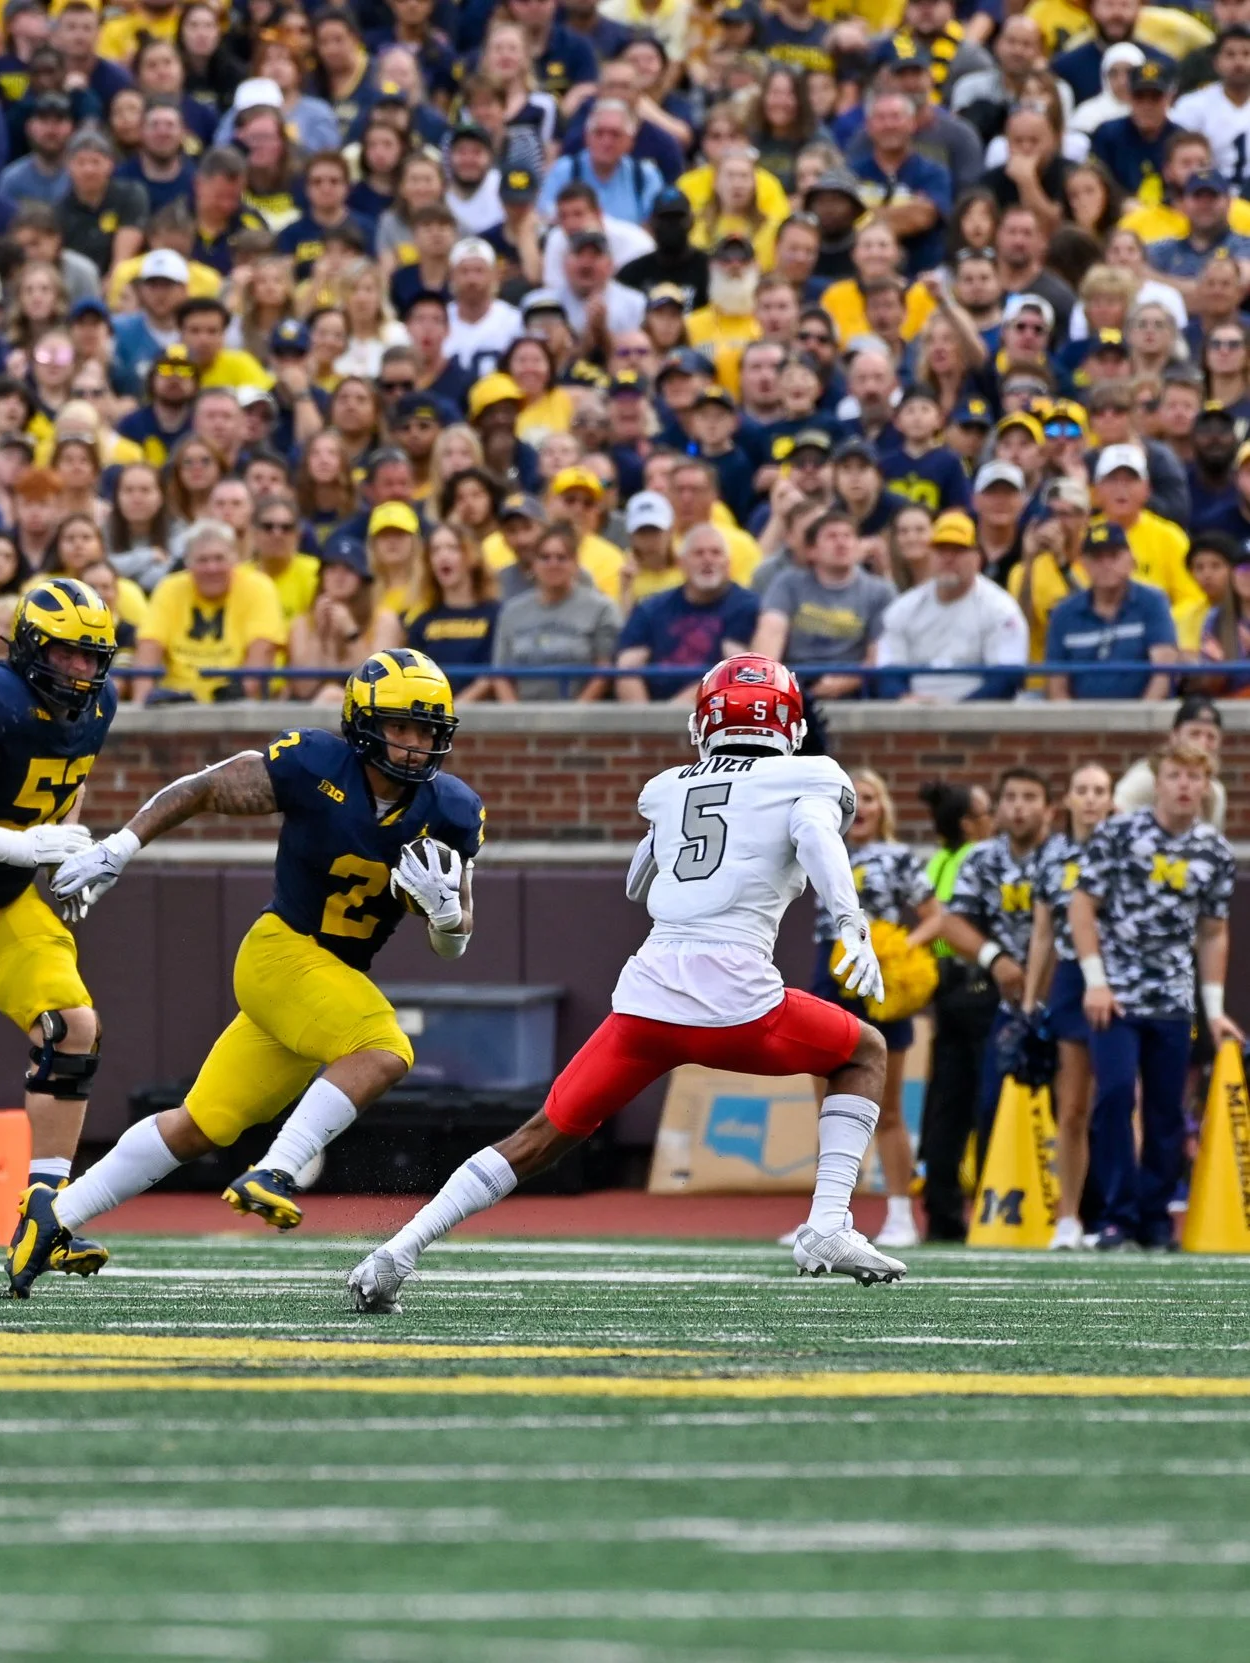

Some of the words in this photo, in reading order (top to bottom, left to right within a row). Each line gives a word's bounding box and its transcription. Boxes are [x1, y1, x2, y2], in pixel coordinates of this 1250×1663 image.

[187, 607, 224, 641] M
[753, 701, 767, 720] 5
[269, 731, 300, 761] 2
[673, 782, 732, 883] 5
[1151, 854, 1188, 890] M
[320, 853, 391, 939] 2
[1002, 882, 1033, 912] M
[981, 1188, 1026, 1225] M
